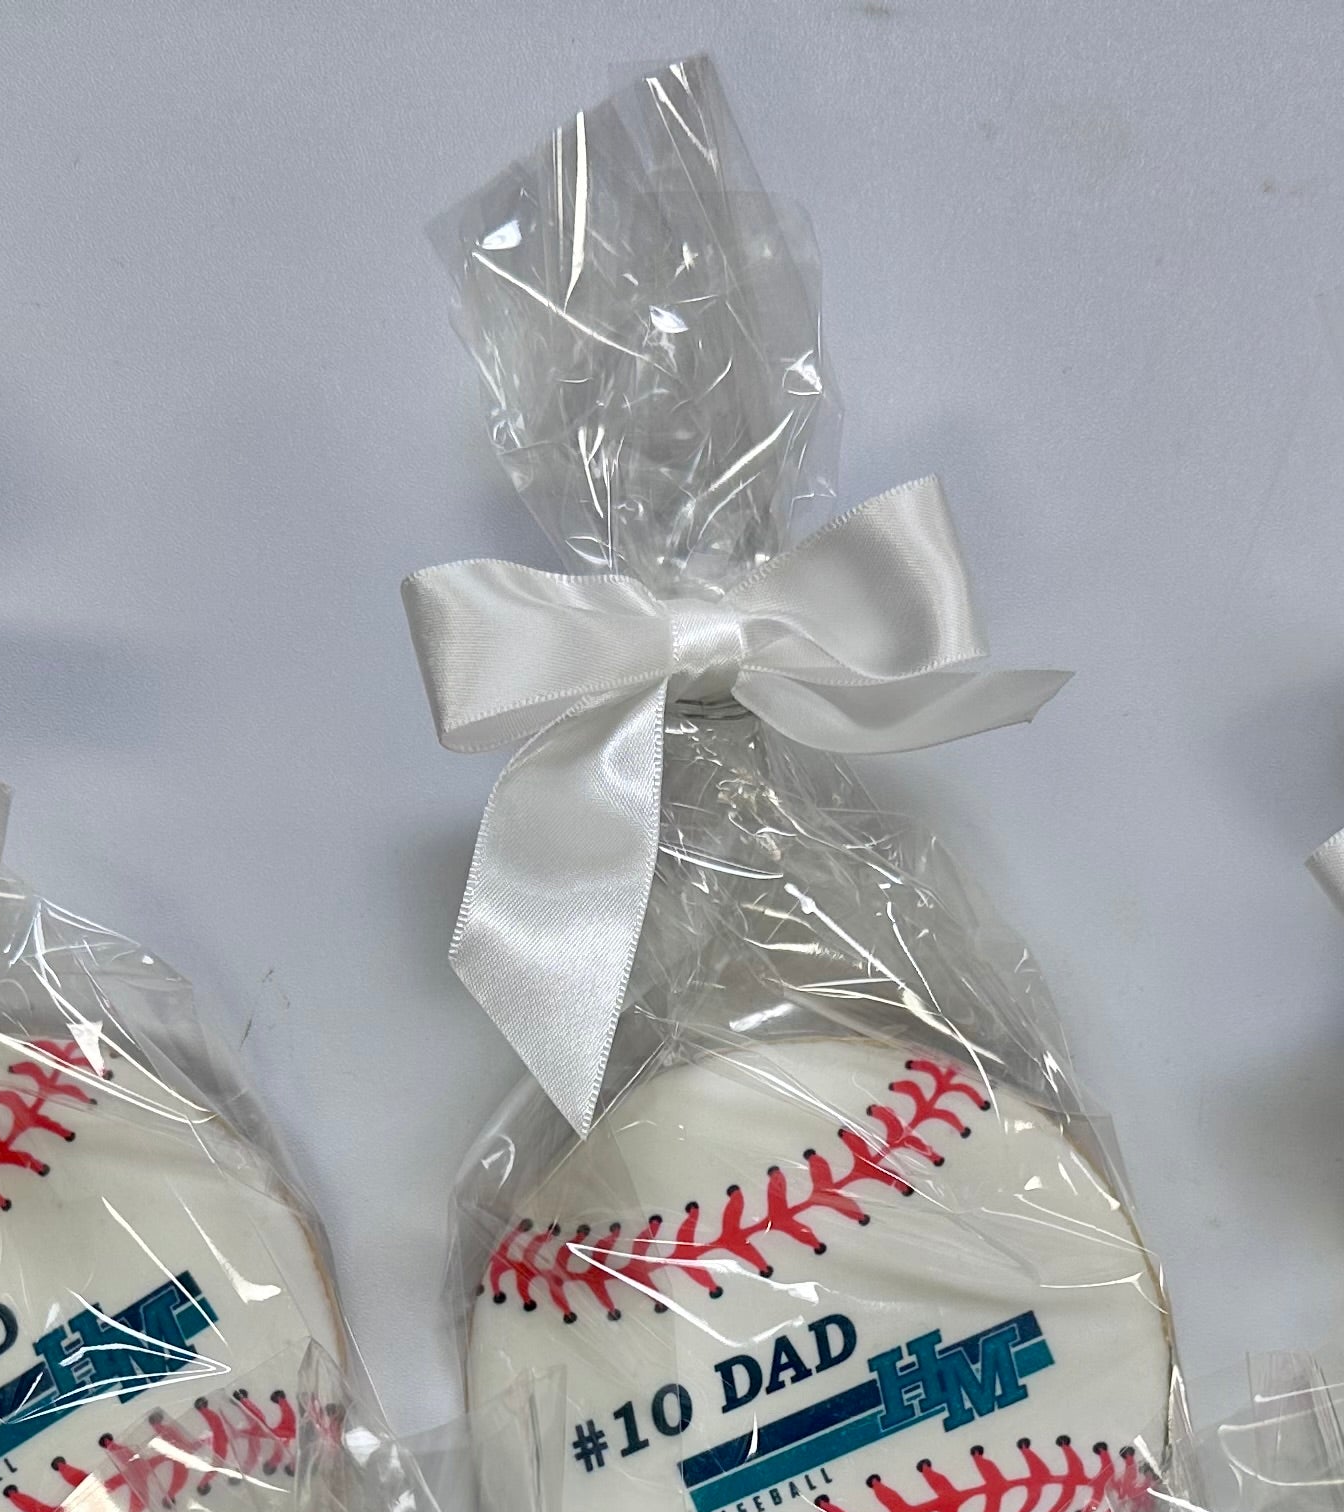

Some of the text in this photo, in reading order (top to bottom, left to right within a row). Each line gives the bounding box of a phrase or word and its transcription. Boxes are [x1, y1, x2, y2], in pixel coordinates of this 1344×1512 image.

[32, 1283, 200, 1404] HM
[572, 1313, 858, 1473] #10 DAD
[868, 1323, 1029, 1432] HM
